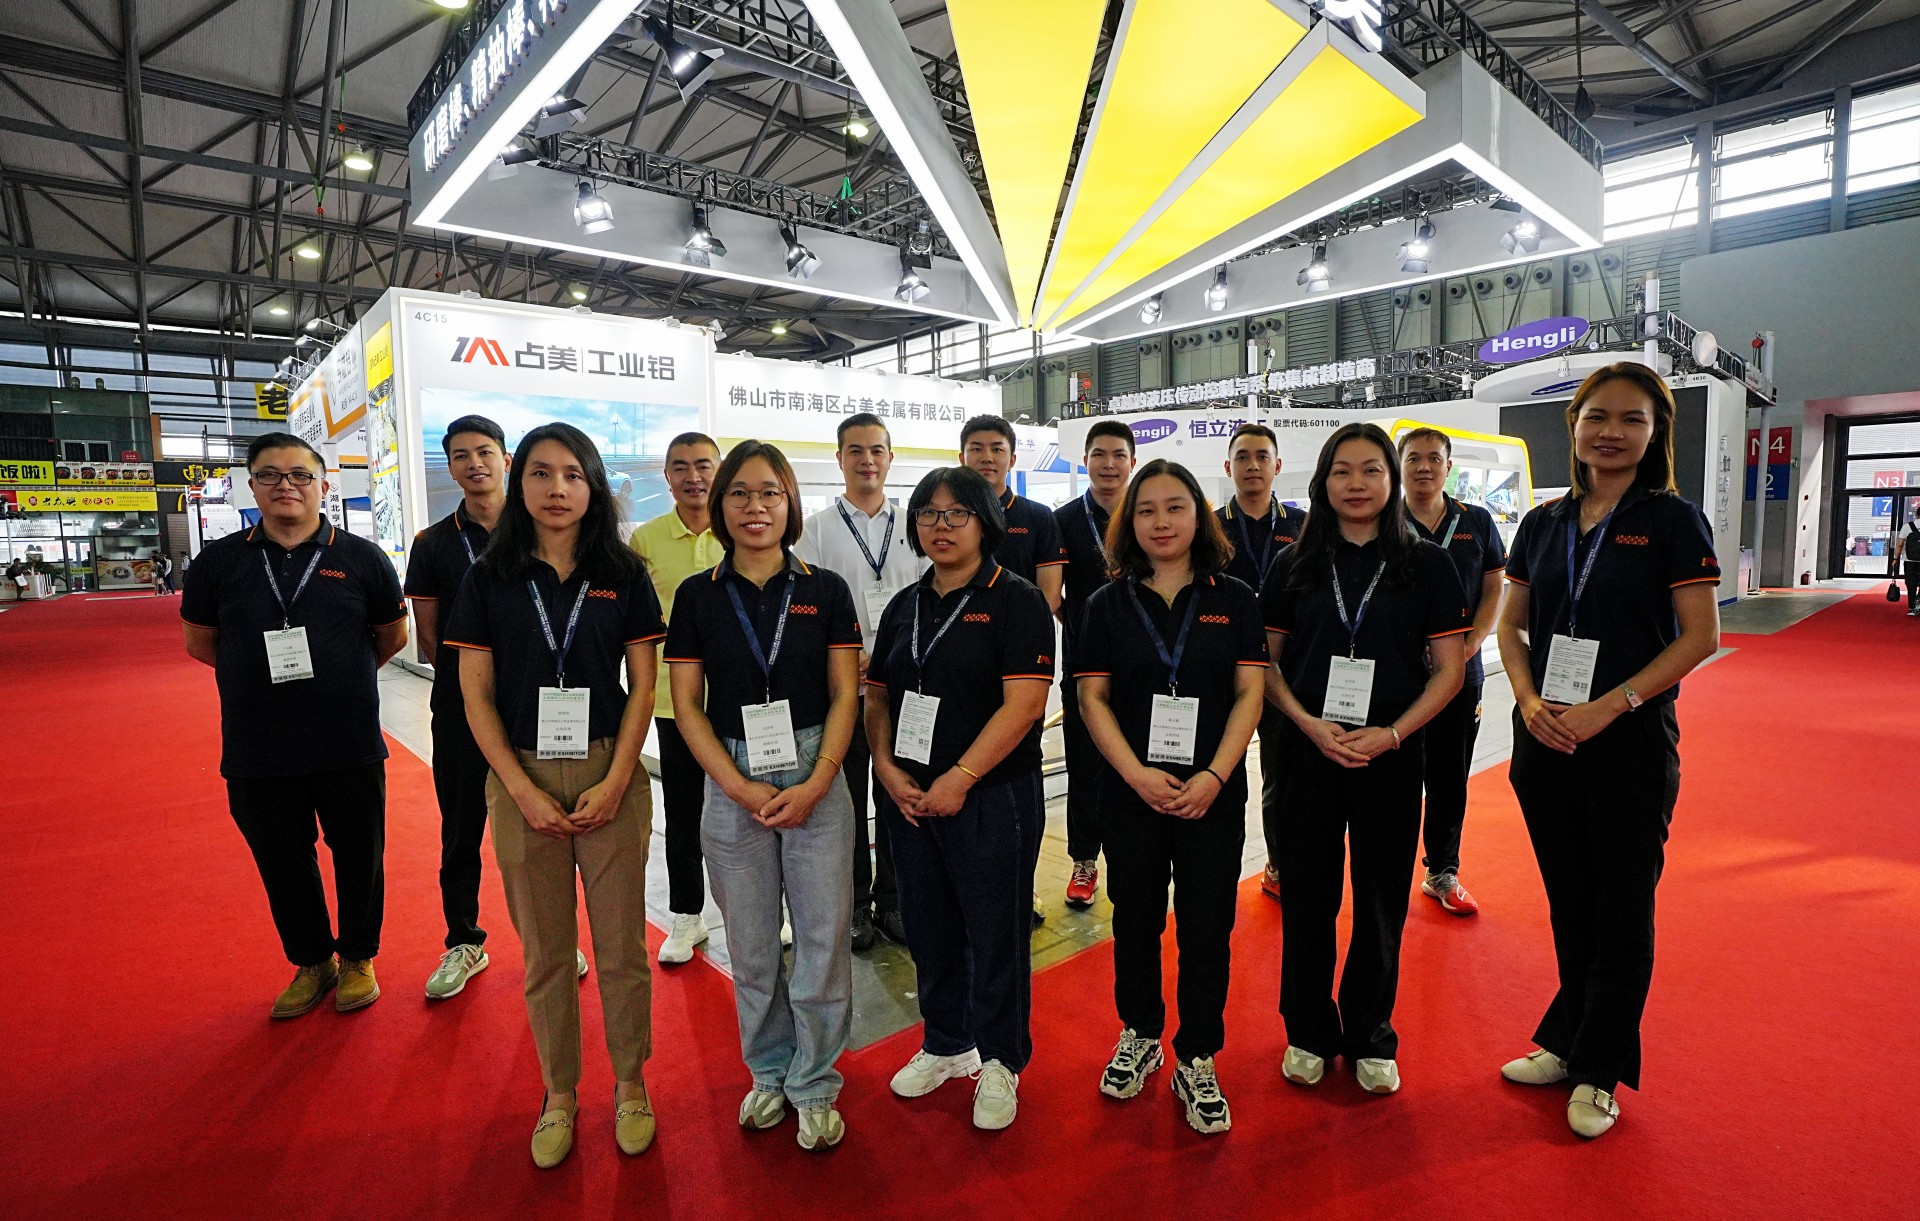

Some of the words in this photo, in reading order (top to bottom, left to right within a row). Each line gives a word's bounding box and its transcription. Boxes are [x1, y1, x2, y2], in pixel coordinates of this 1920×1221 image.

[415, 311, 448, 324] 4C15
[1492, 326, 1576, 353] Hengli
[588, 348, 675, 381] 工业铝
[728, 385, 966, 423] 佛山市南海区占美金属有限公司
[1132, 425, 1170, 438] engli
[1189, 418, 1267, 439] 恒立液
[1876, 476, 1900, 488] N3
[1882, 499, 1892, 512] 7
